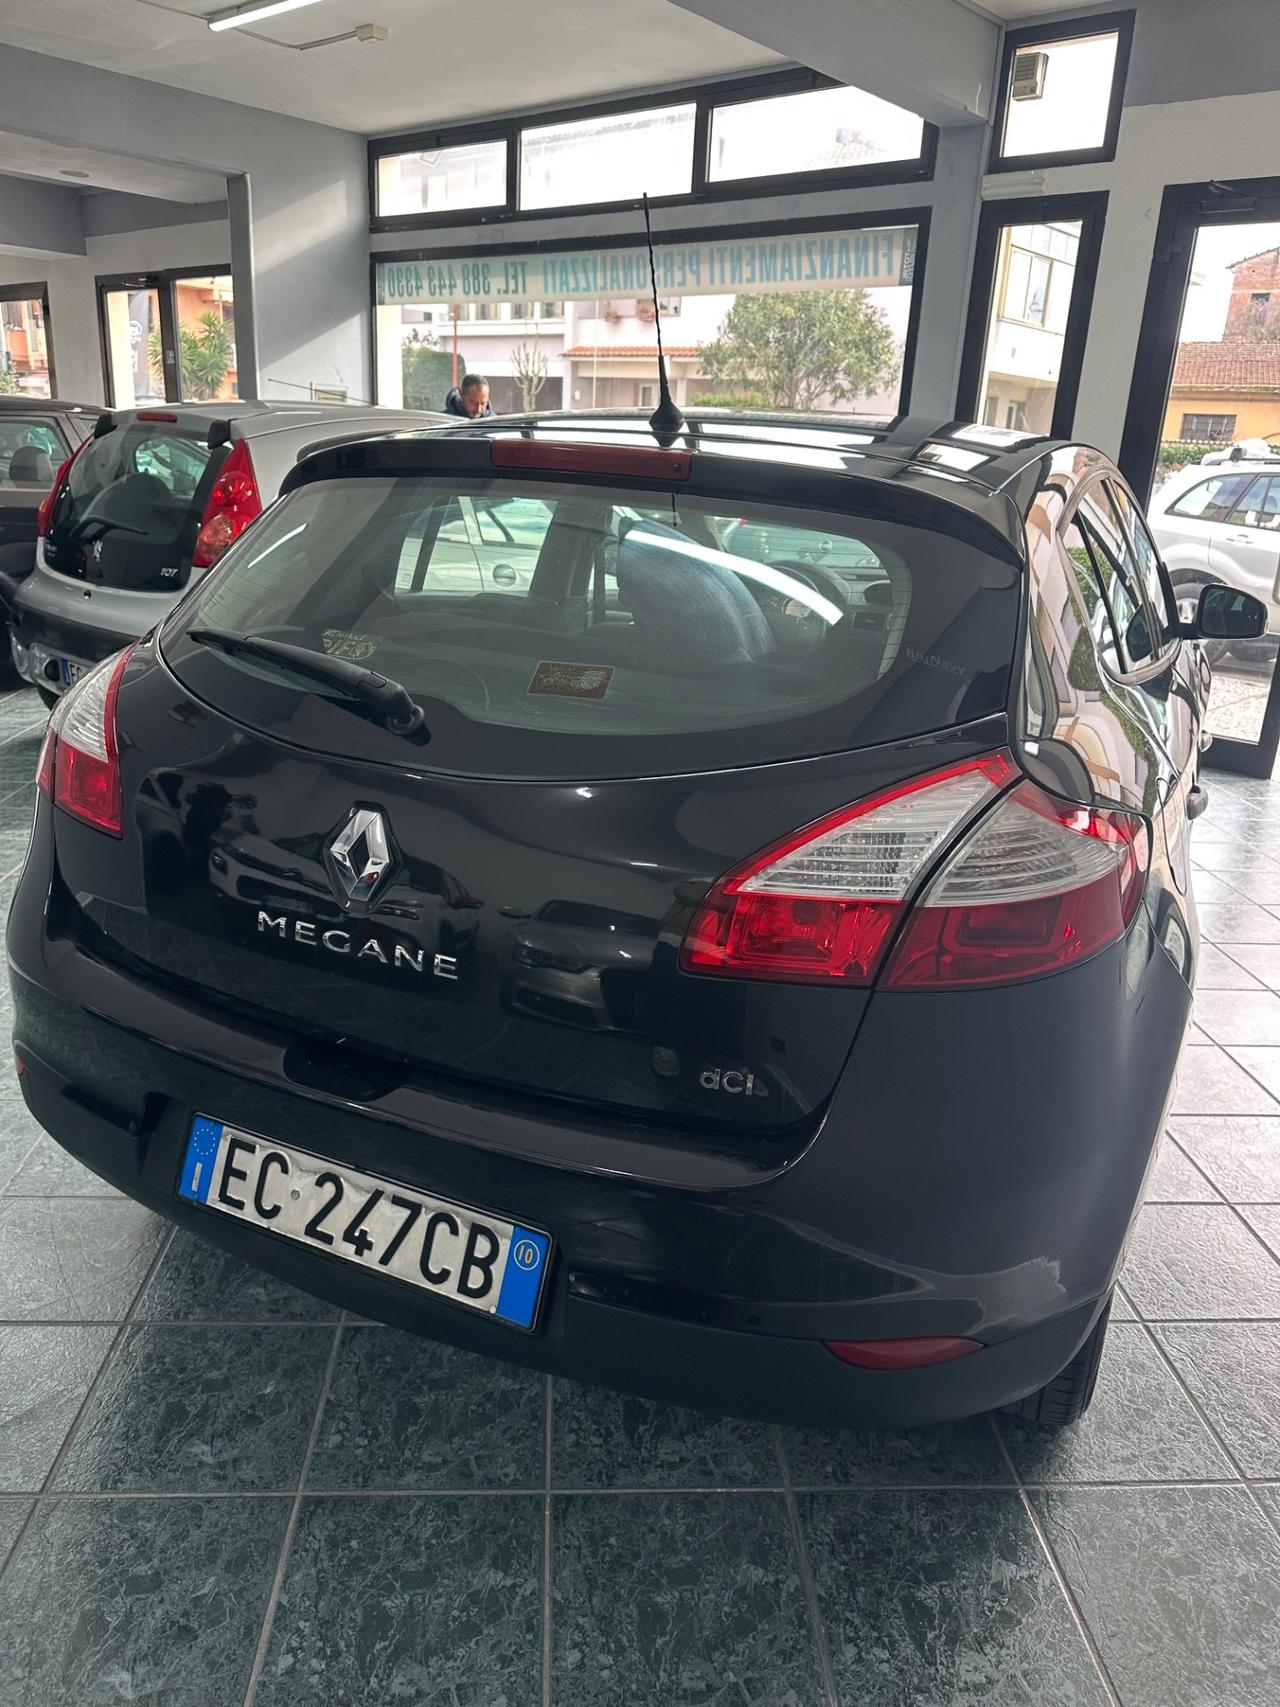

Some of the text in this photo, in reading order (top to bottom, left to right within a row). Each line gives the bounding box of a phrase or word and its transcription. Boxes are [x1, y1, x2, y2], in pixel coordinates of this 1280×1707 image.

[160, 567, 178, 578] 107
[257, 910, 458, 979] MEGANE
[517, 1244, 534, 1265] 10
